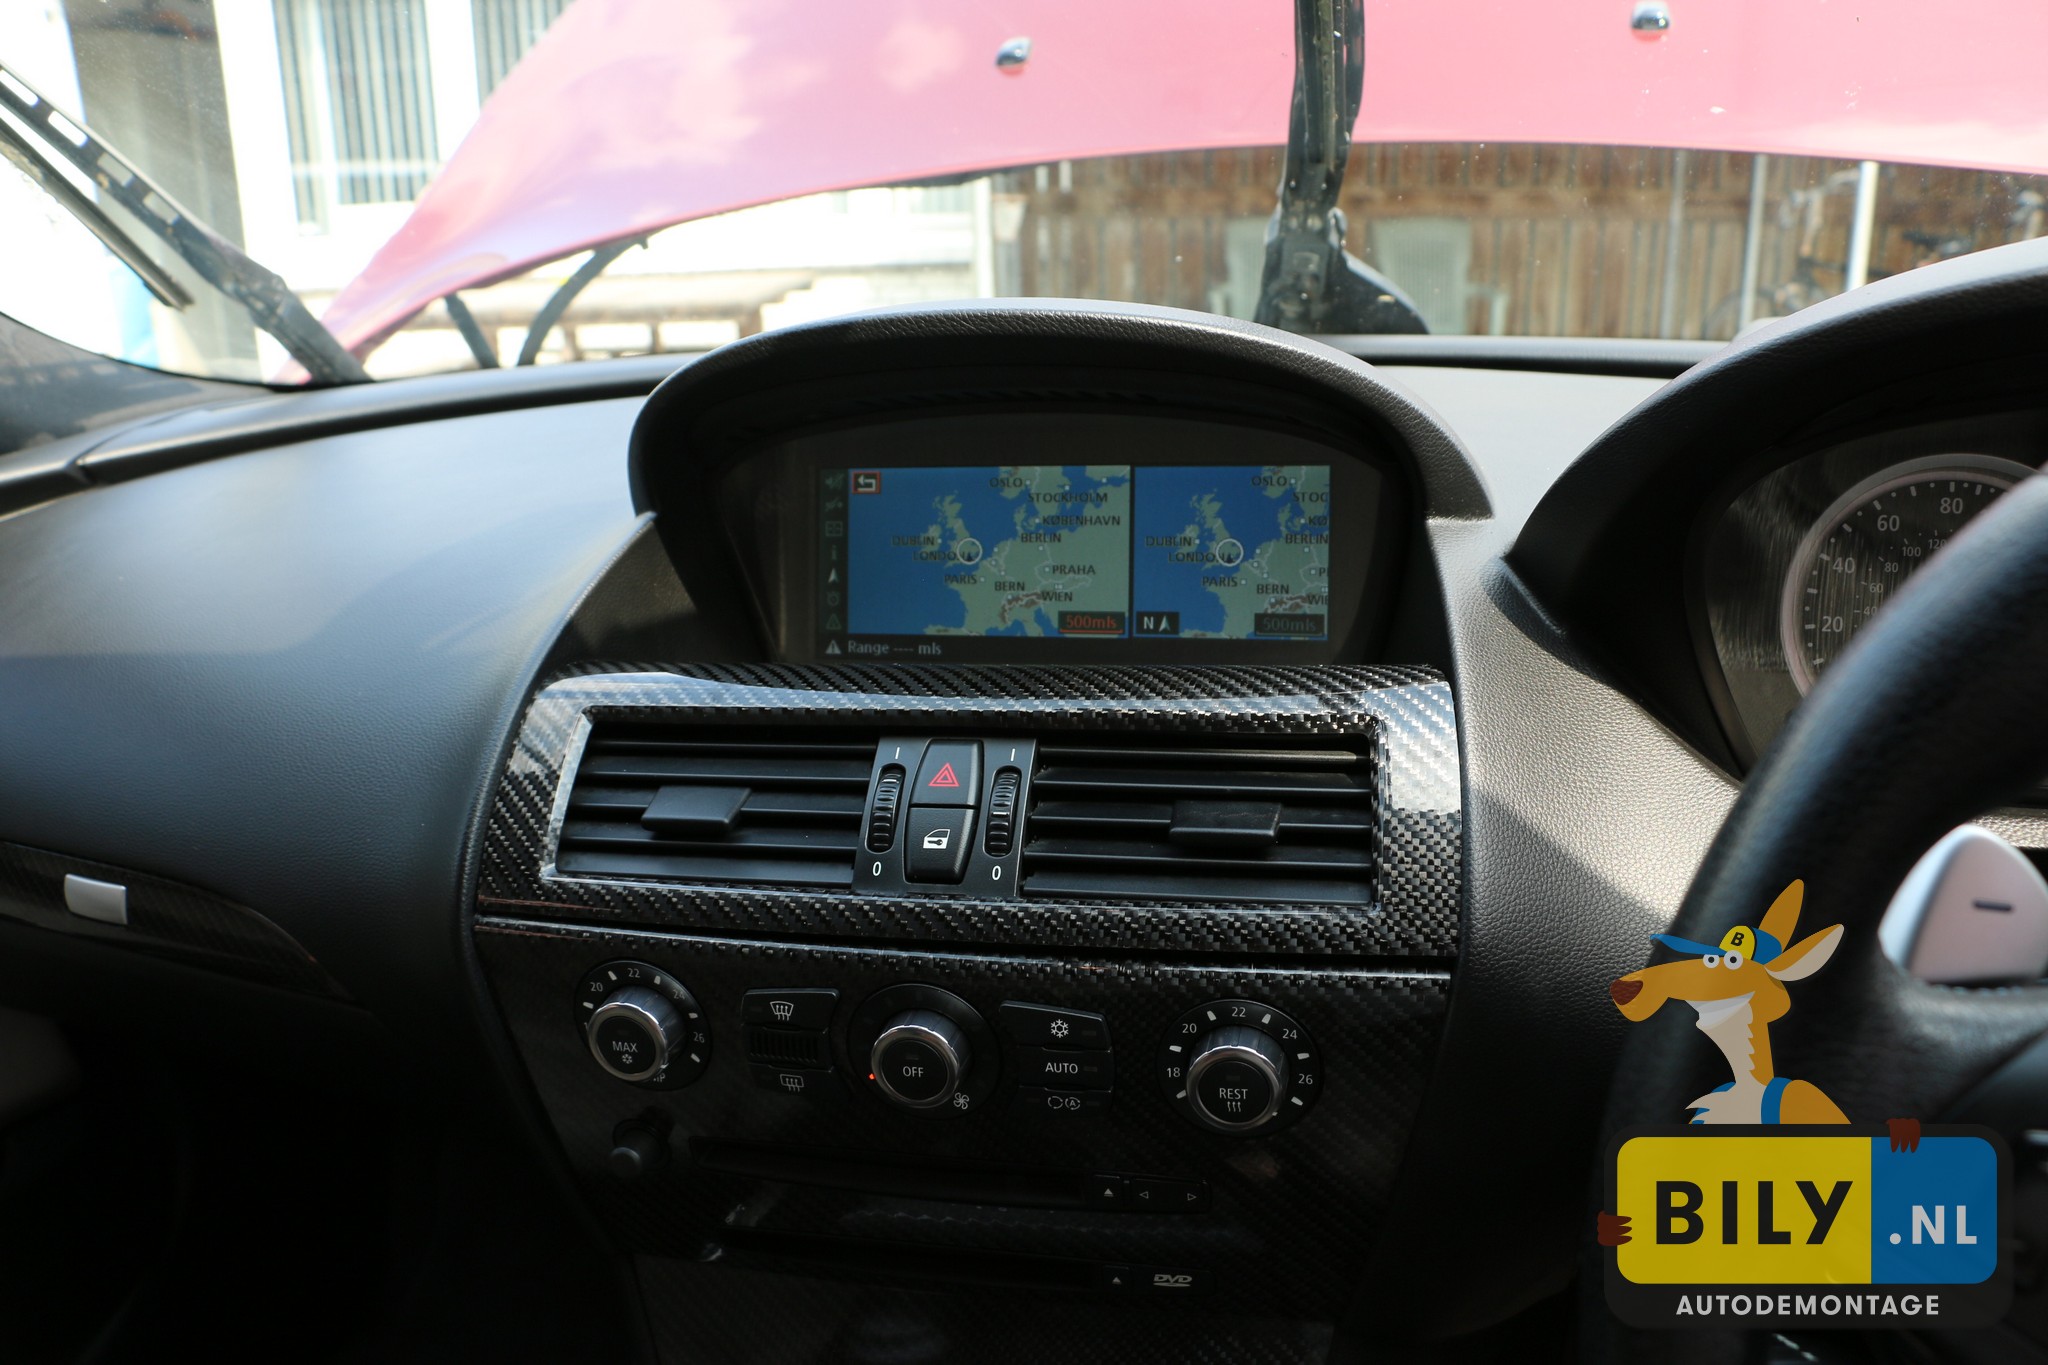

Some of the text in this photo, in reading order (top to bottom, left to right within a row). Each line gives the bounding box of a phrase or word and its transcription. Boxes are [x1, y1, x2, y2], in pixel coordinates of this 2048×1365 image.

[989, 477, 1023, 489] OSLO
[1251, 475, 1288, 487] OSLO
[1028, 491, 1108, 504] STOCKHOLM
[1939, 497, 1964, 514] 80
[1042, 514, 1121, 526] KØBENHAVN
[1877, 515, 1900, 531] 60
[892, 535, 935, 546] DUBLIN
[1021, 532, 1062, 544] BERLIN
[1145, 535, 1192, 547] DUBLIN
[1285, 533, 1328, 545] BERLIN
[1902, 546, 1922, 558] 100
[1052, 564, 1096, 575] PRAHA
[1832, 557, 1856, 574] 40
[1884, 562, 1899, 573] 80
[944, 574, 977, 586] PARIS
[1202, 576, 1238, 588] PARIS
[994, 581, 1025, 592] BERN
[1256, 583, 1290, 595] BERN
[1869, 582, 1884, 593] 60
[1041, 591, 1073, 602] WIEN
[1066, 615, 1117, 629] 500mls
[1143, 616, 1154, 629] N
[1263, 617, 1317, 632] 500mls
[1821, 615, 1844, 632] 20
[848, 640, 889, 656] Range
[918, 642, 942, 656] mls
[627, 967, 641, 978] 22
[590, 981, 604, 992] 20
[1231, 1006, 1246, 1018] 22
[1182, 1023, 1197, 1034] 20
[1282, 1028, 1298, 1040] 24
[693, 1031, 705, 1043] 26
[612, 1040, 638, 1052] MAX
[902, 1065, 924, 1078] OFF
[1045, 1062, 1079, 1075] AUTO
[1166, 1067, 1181, 1078] 18
[1298, 1073, 1313, 1085] 26
[1219, 1087, 1249, 1100] REST
[1153, 1273, 1193, 1284] DVD
